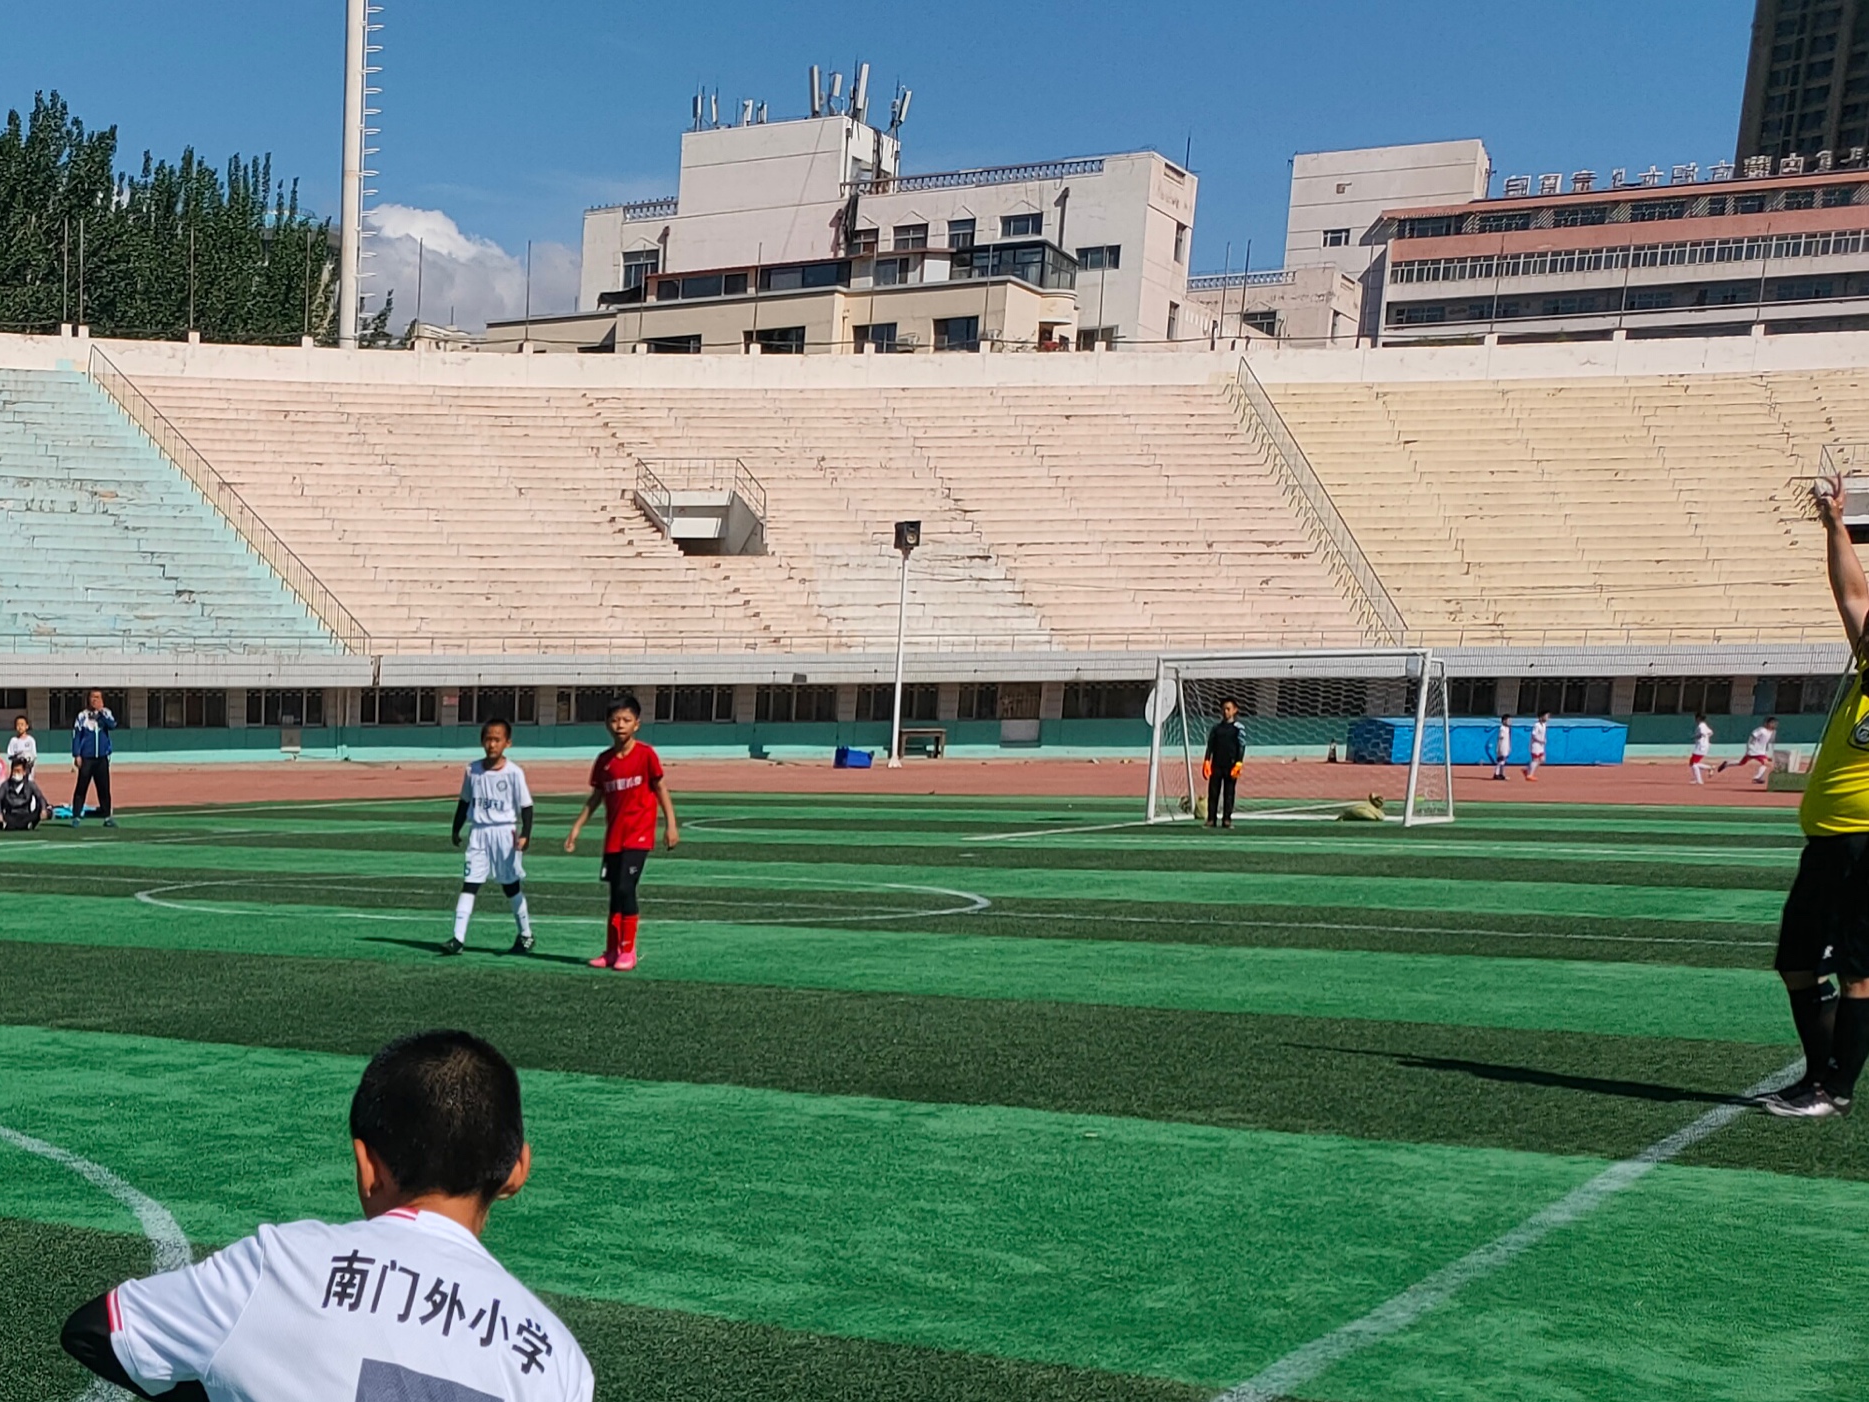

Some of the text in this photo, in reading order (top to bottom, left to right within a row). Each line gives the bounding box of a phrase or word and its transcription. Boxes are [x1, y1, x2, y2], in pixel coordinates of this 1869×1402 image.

[321, 1249, 554, 1375] 南门外小学
